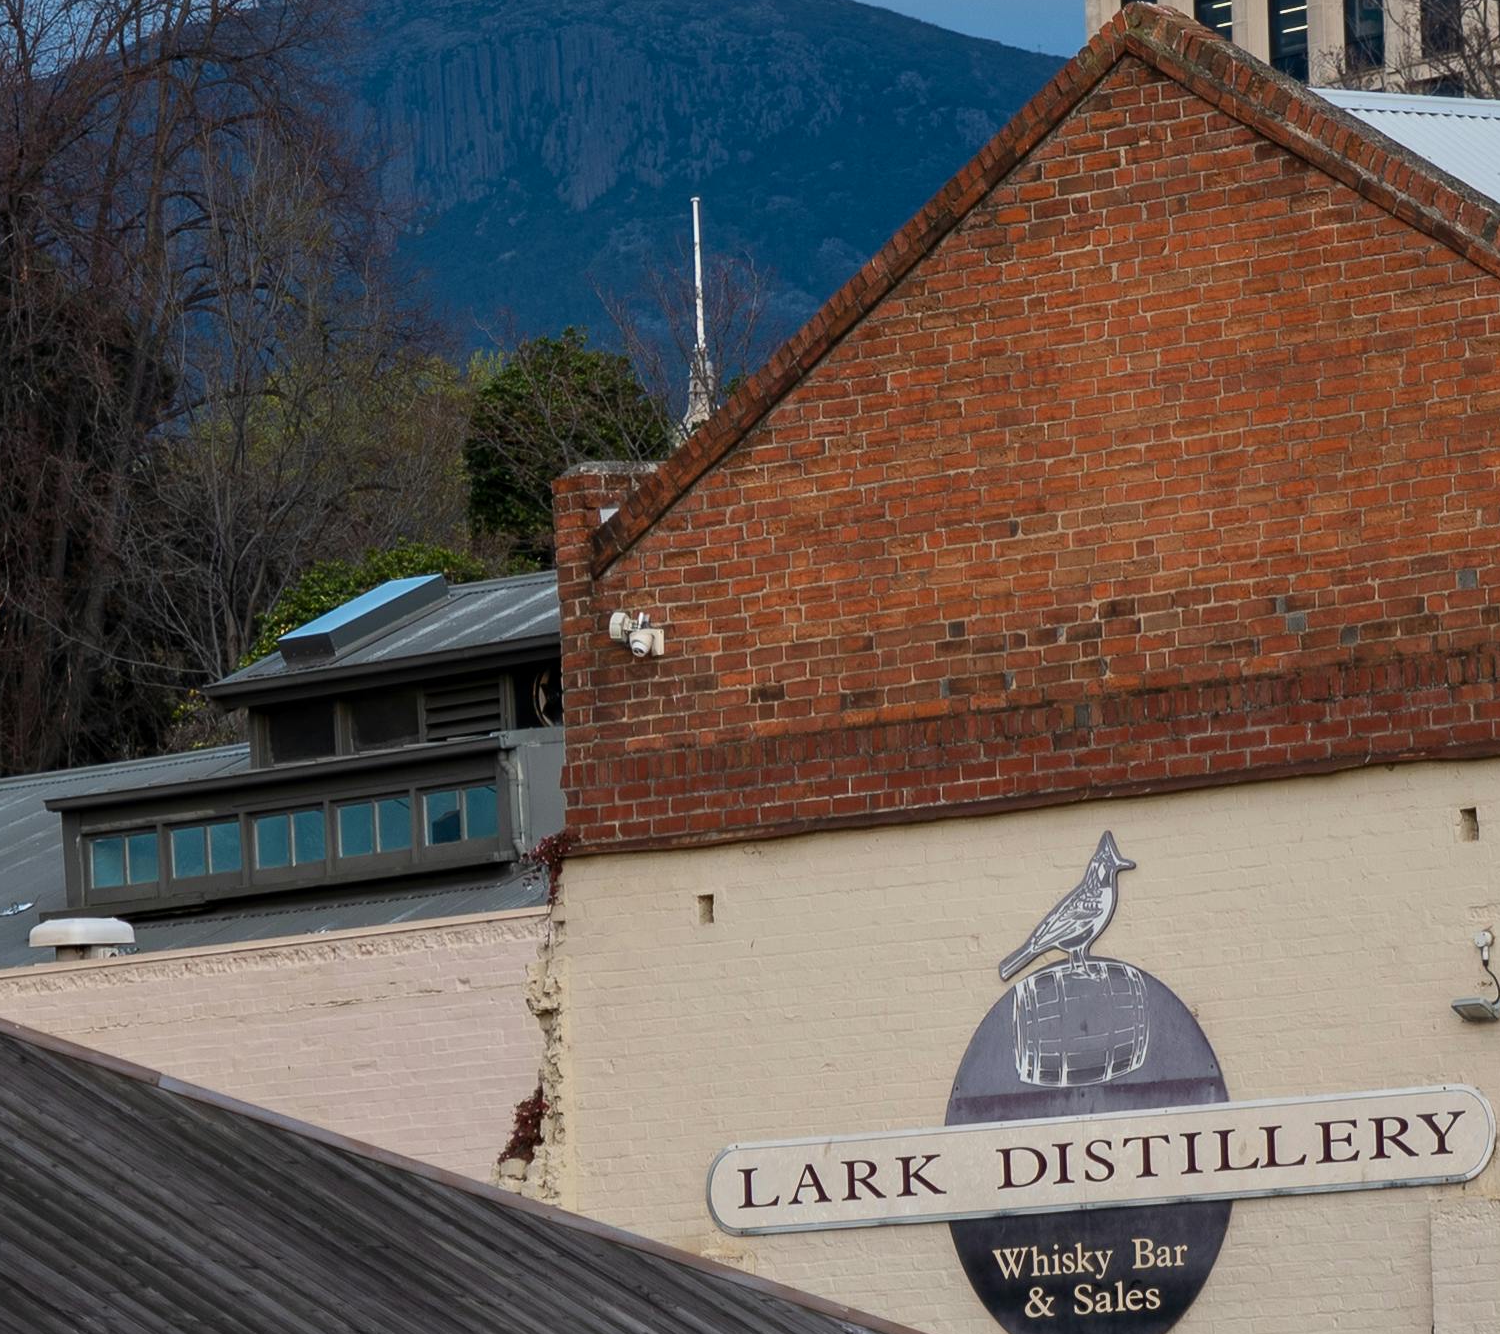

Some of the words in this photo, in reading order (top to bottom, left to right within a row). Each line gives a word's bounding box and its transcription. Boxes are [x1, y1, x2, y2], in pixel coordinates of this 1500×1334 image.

[737, 1154, 946, 1209] LARK
[996, 1110, 1466, 1190] DISTILLERY
[992, 1240, 1114, 1280] Whisky
[1132, 1238, 1189, 1270] Bar
[1024, 1286, 1054, 1317] &
[1073, 1280, 1161, 1315] Sales
